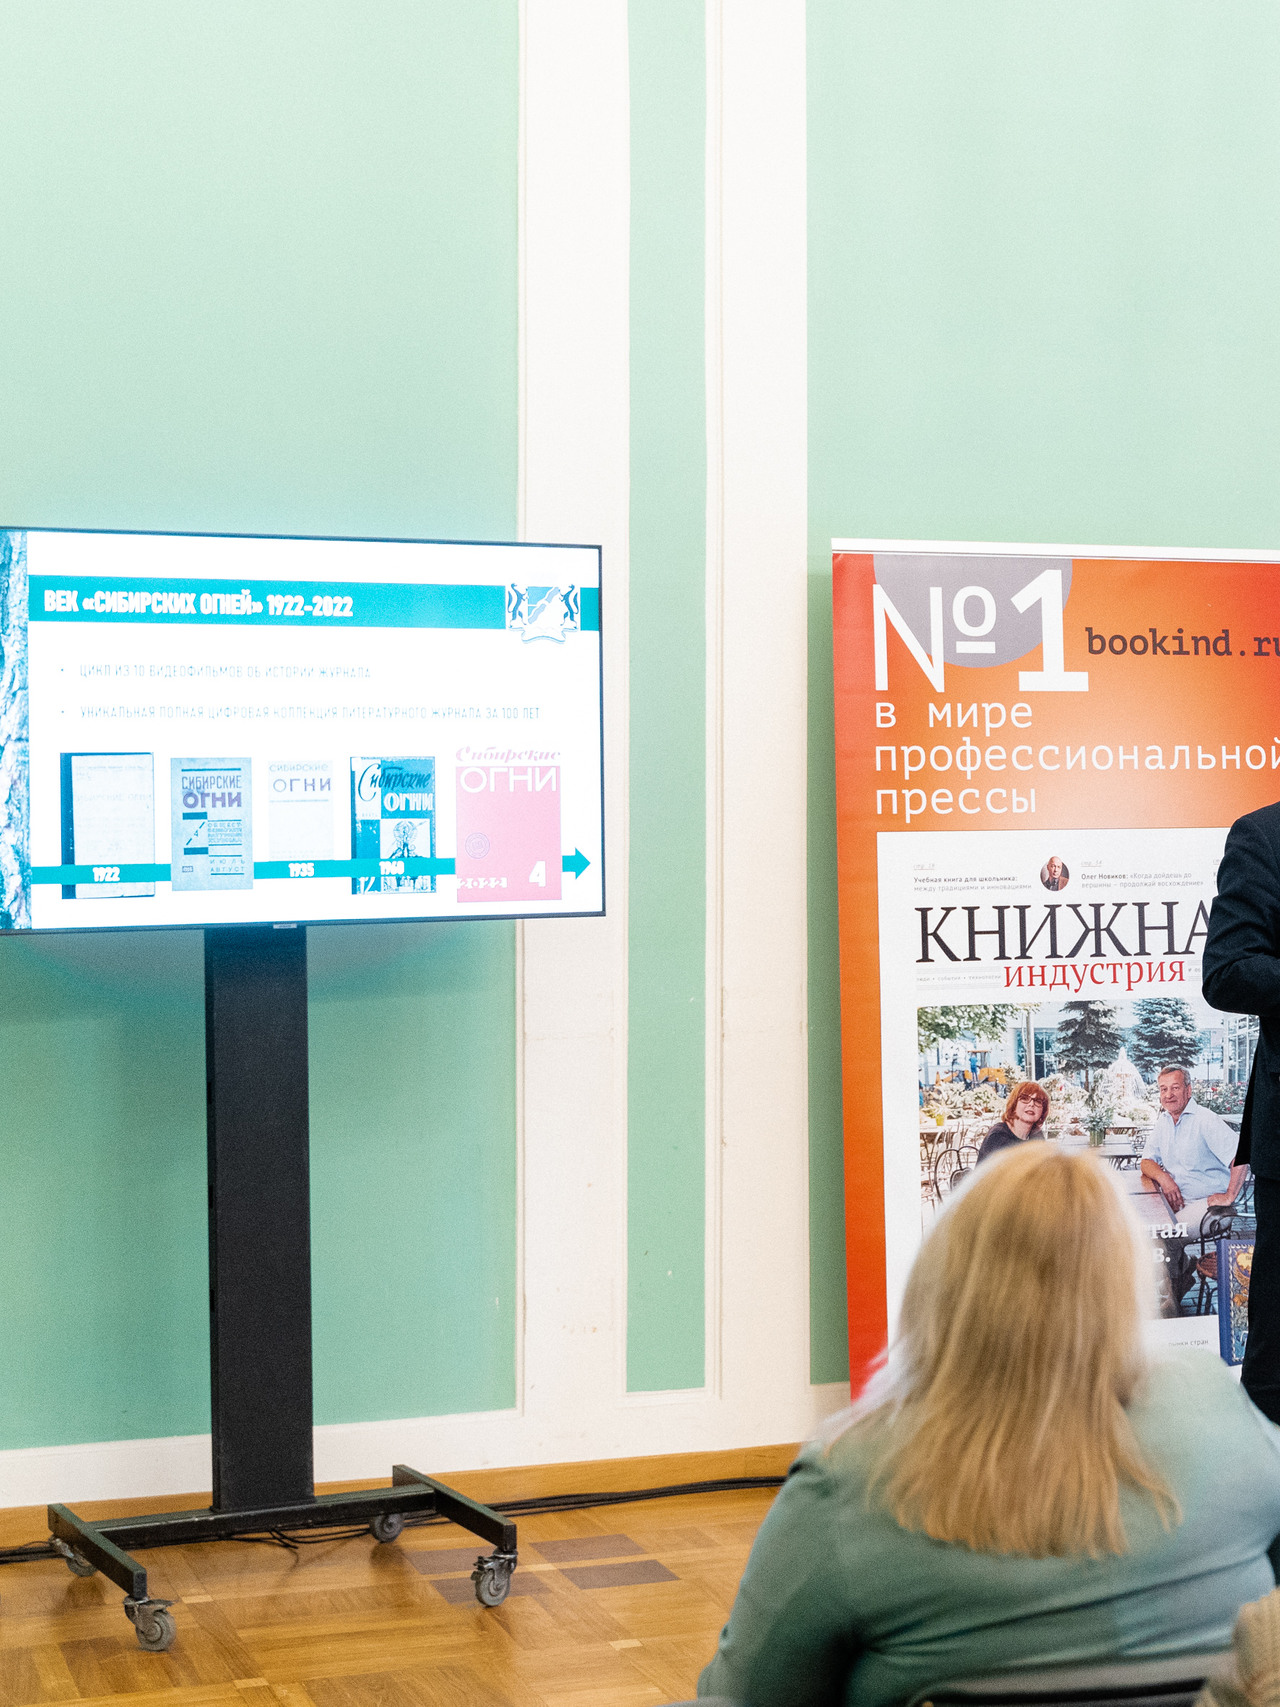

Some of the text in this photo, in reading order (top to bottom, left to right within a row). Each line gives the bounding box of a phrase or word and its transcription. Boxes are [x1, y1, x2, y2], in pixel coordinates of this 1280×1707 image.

[44, 589, 354, 617] ВЕК «СИБИРСКИХ ОГНЕЙ» 1922-2022
[80, 664, 372, 679] ЦИКЛ ИЗ 10 ВИДЕОФИЛЬМОВ ОБ ИСТОРИИ ЖУРНАЛА
[80, 705, 541, 720] УНИКАЛЬНАЯ ПОЛНАЯ ЦИФРОВАЯ КОЛЛЕКЦИЯ ЛИТЕРАТУРНОГО ЖУРНАЛА ЗА 100 ЛЕТ
[875, 701, 1033, 737] в мире
[456, 746, 561, 763] Сибирские
[181, 775, 242, 790] СИБИРСКИЕ
[273, 777, 331, 792] ОГНИ
[358, 763, 431, 801] Сибирские
[460, 767, 557, 793] ОГНИ
[182, 791, 242, 808] ОГНИ
[383, 792, 434, 811] ОГНИ
[876, 787, 1036, 823] прессы
[92, 866, 120, 881] 1922
[528, 860, 546, 887] 4
[913, 876, 942, 884] Учебная
[1003, 961, 1186, 993] индустрия
